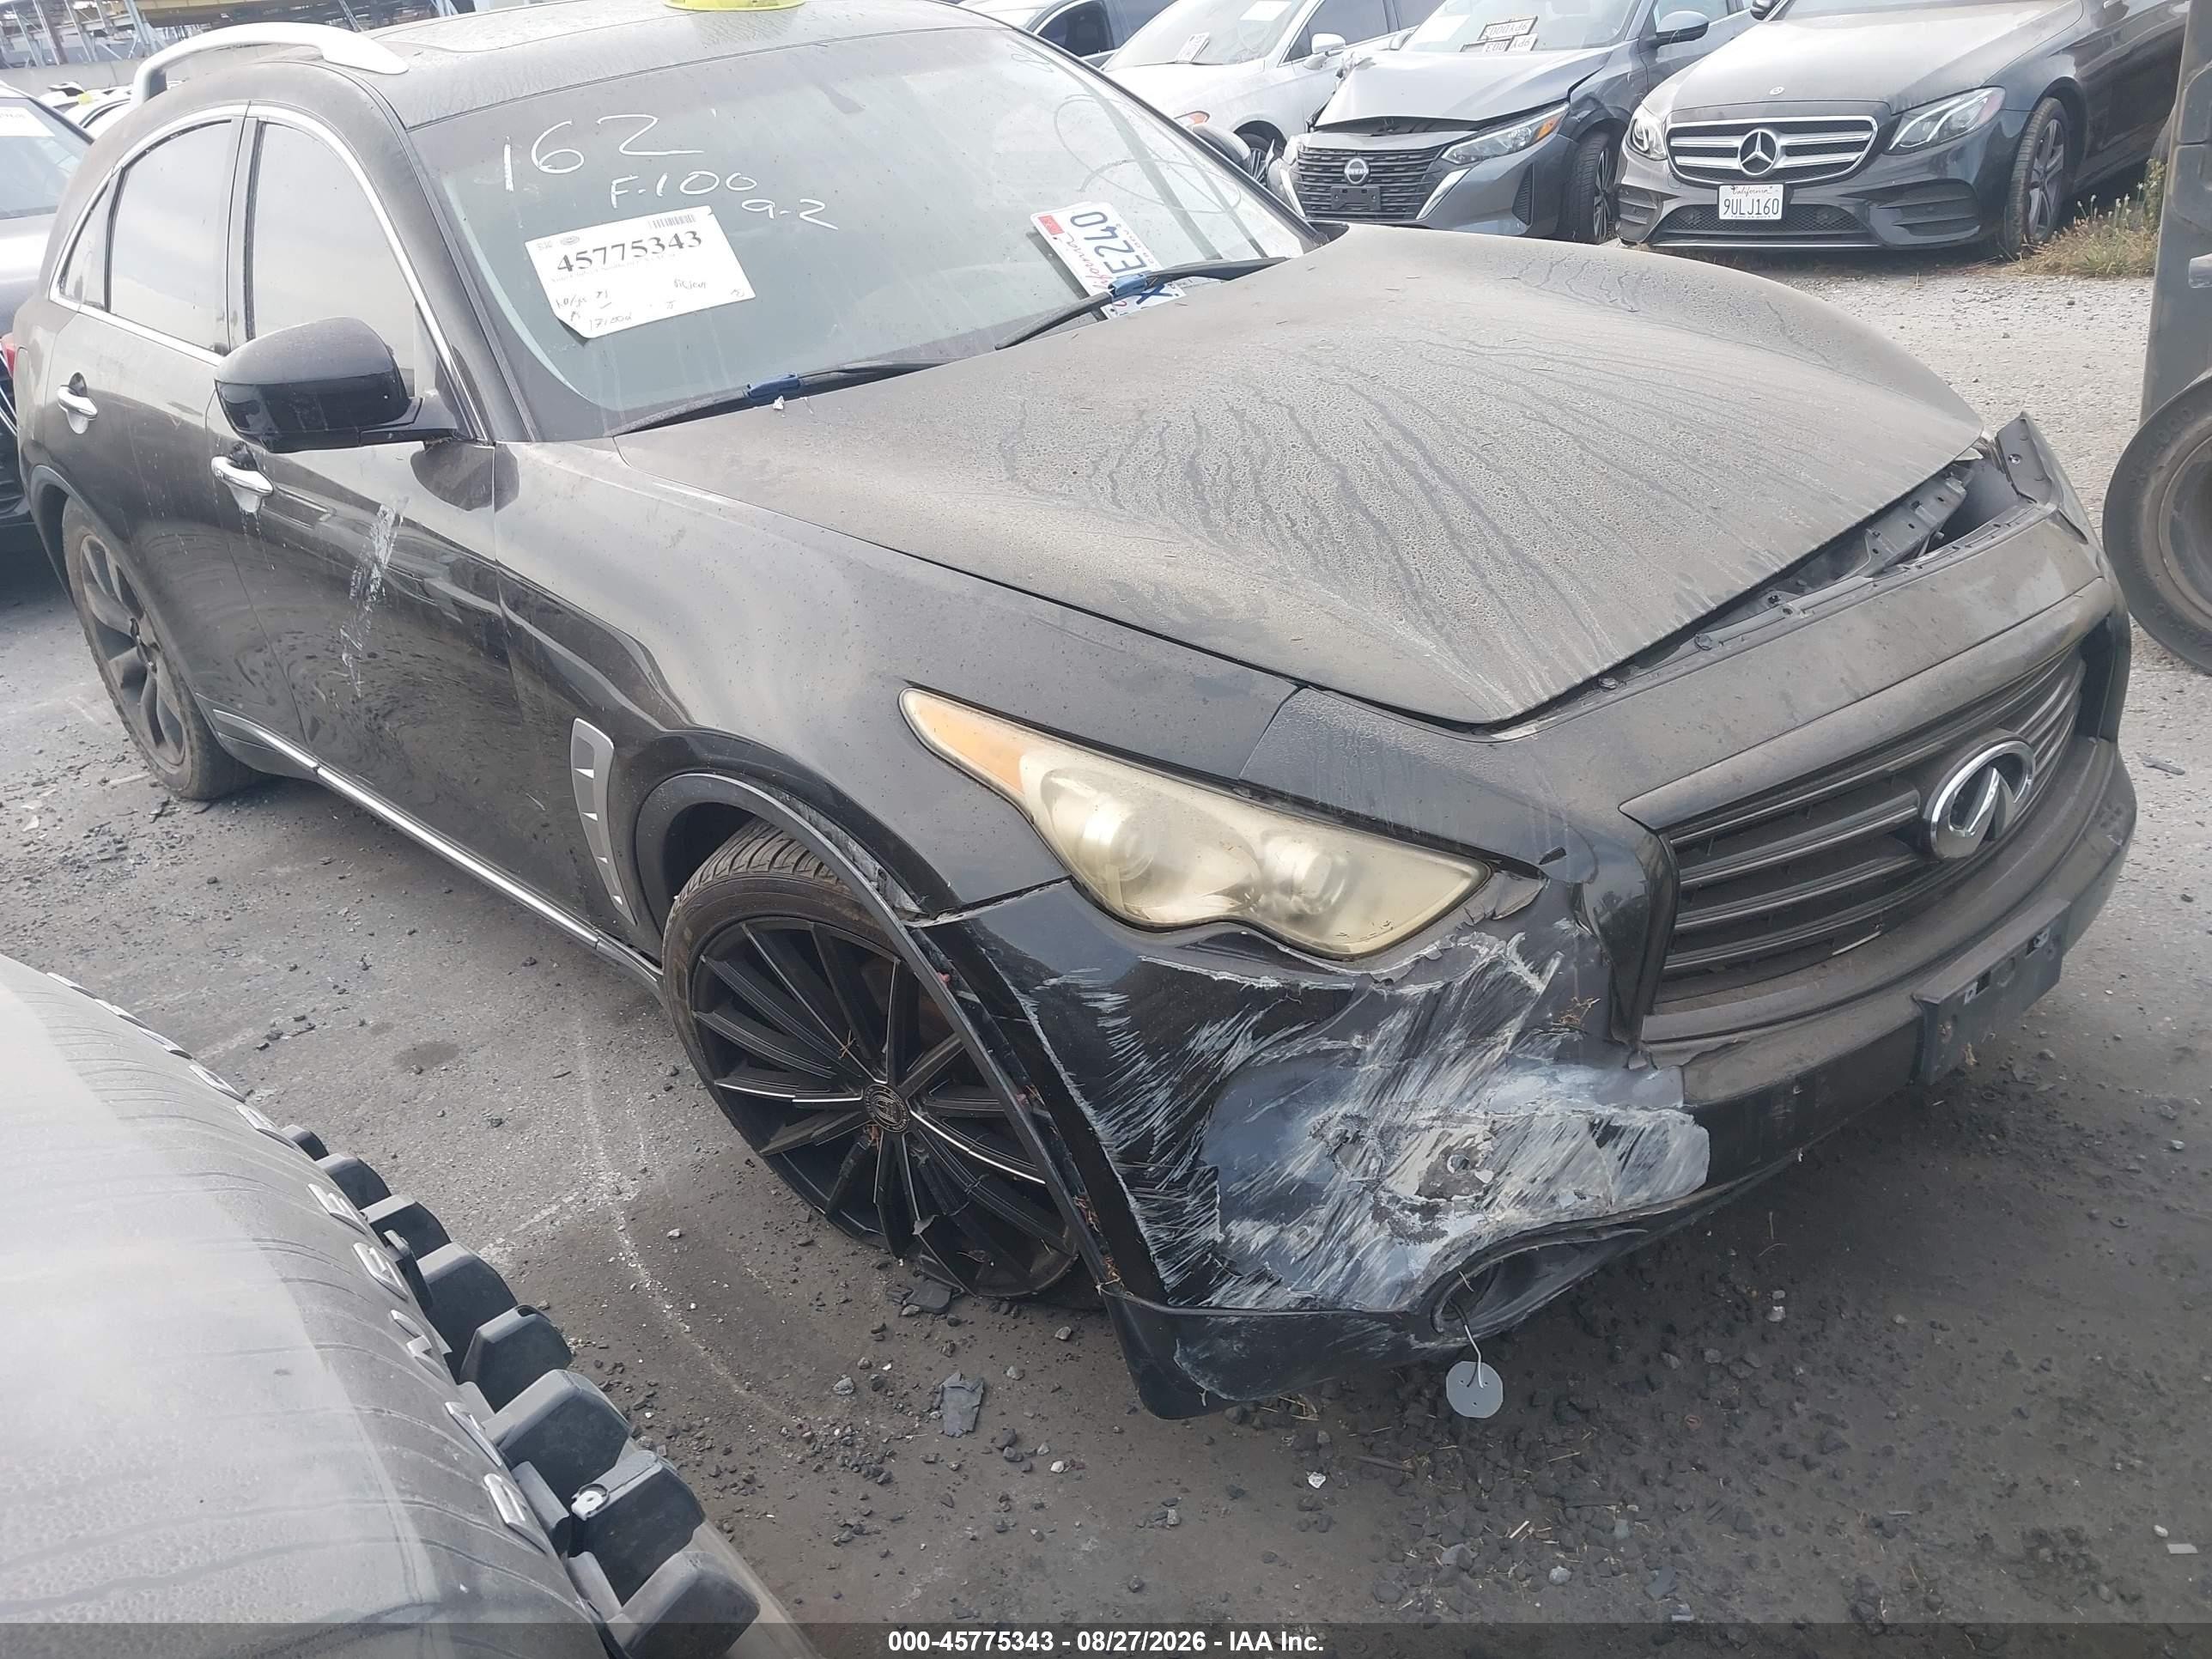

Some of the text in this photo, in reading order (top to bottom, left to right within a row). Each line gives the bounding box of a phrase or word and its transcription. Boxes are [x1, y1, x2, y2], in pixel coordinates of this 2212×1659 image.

[503, 114, 704, 192] 162
[1731, 185, 1769, 198] California
[1723, 198, 1780, 216] 9ULJ160
[556, 230, 702, 273] 45775343
